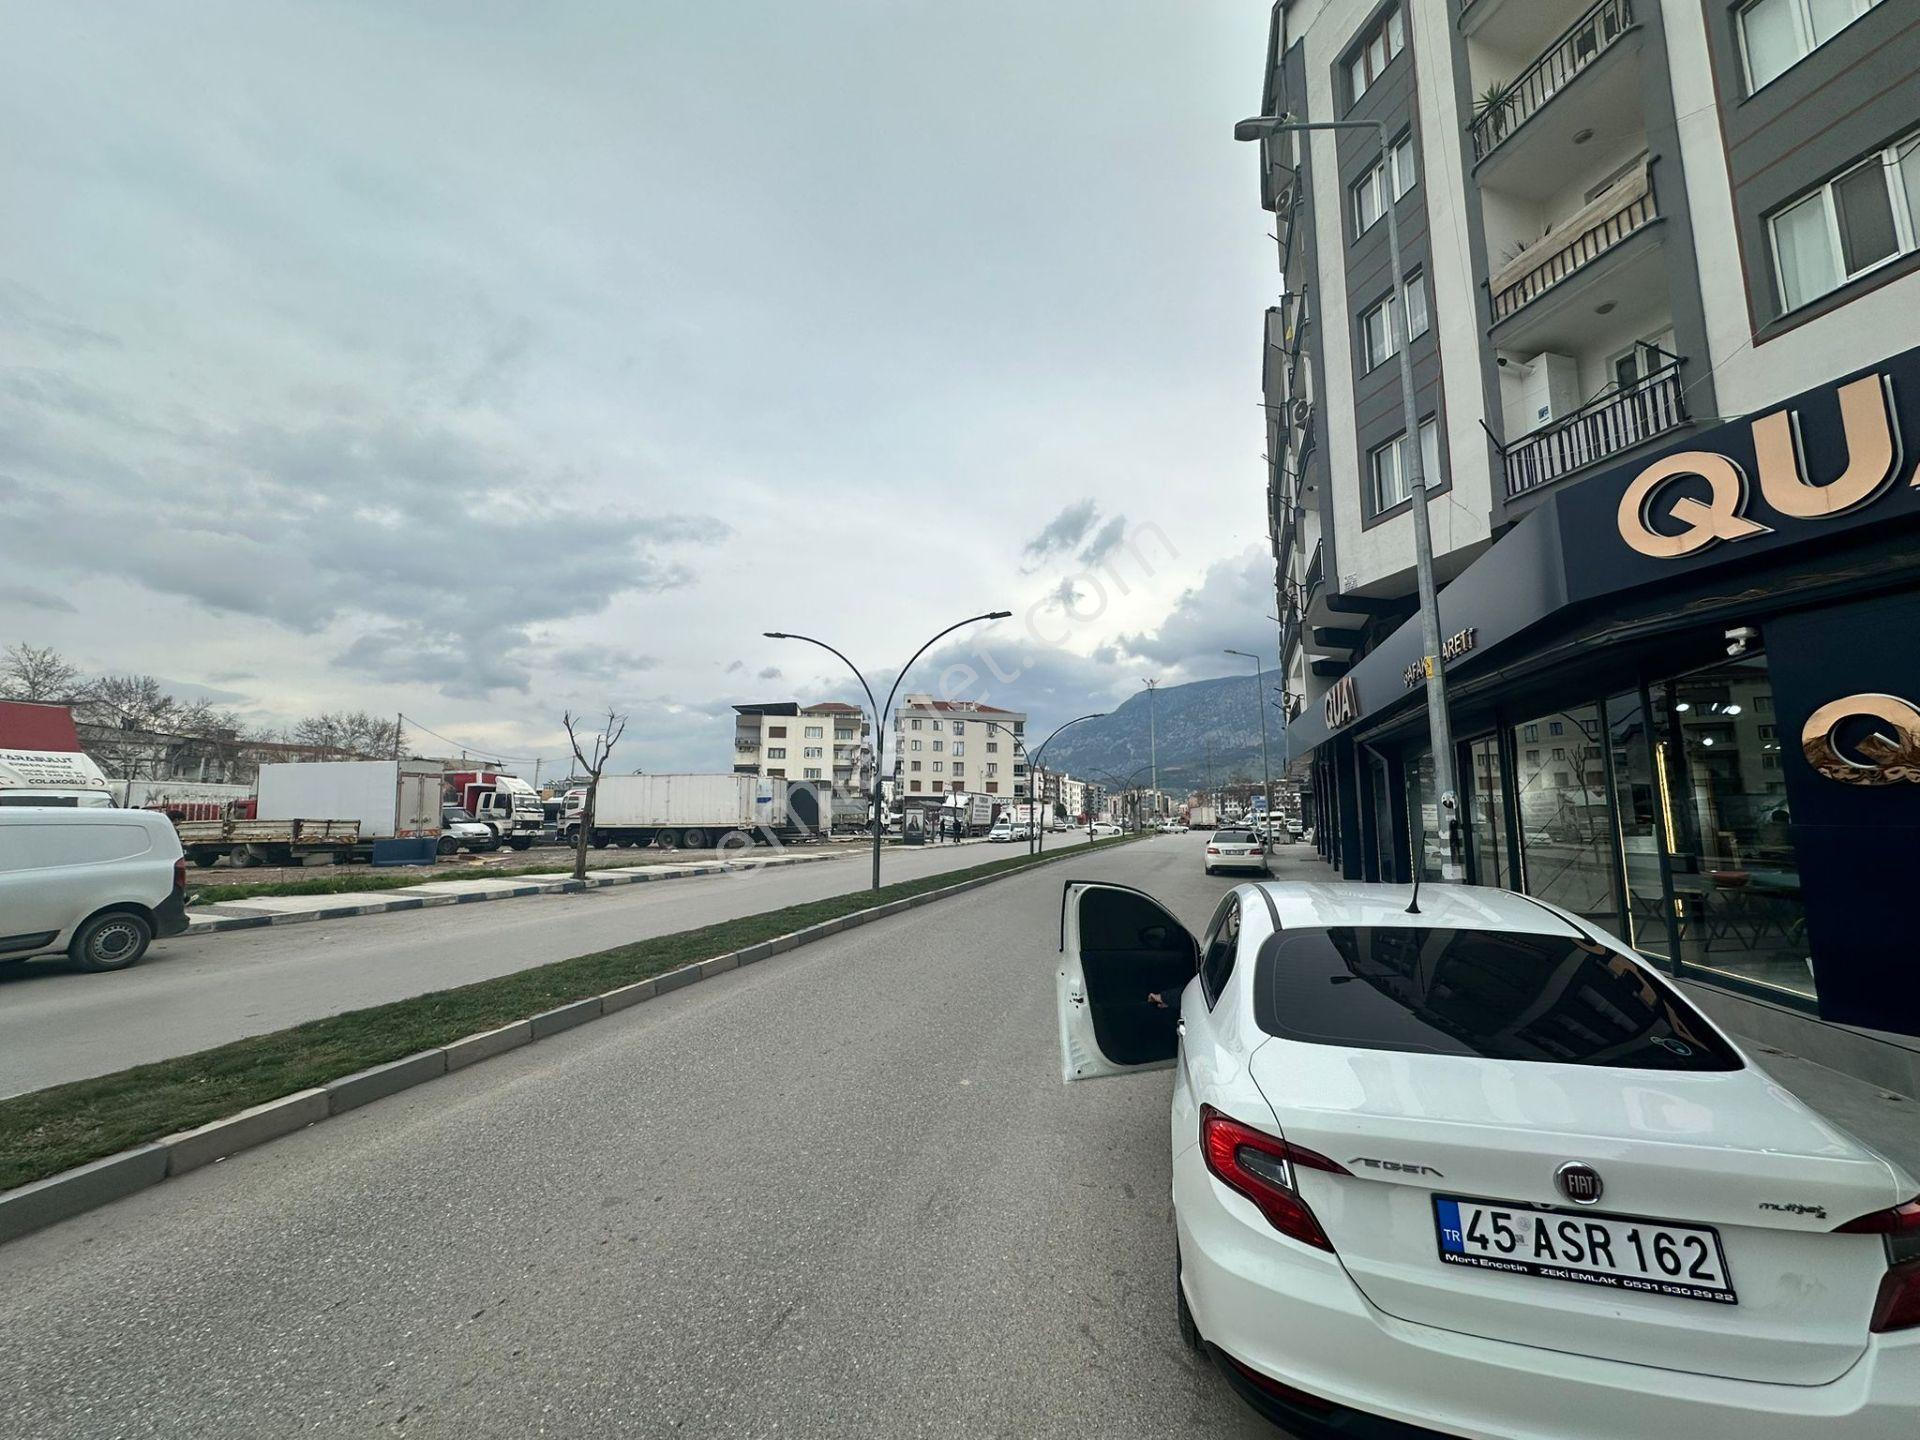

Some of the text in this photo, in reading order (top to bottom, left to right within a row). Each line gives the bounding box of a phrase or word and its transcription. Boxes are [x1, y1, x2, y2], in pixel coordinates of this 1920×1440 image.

[1617, 373, 1920, 559] QU
[1567, 1174, 1593, 1195] FIAT
[1443, 1228, 1461, 1242] TR
[1466, 1209, 1716, 1281] 45 ASR 162
[1570, 1271, 1617, 1286] EMLAK
[1623, 1280, 1658, 1291] 0531
[1662, 1285, 1691, 1296] 930
[1692, 1289, 1713, 1299] 29
[1714, 1292, 1736, 1302] 22
